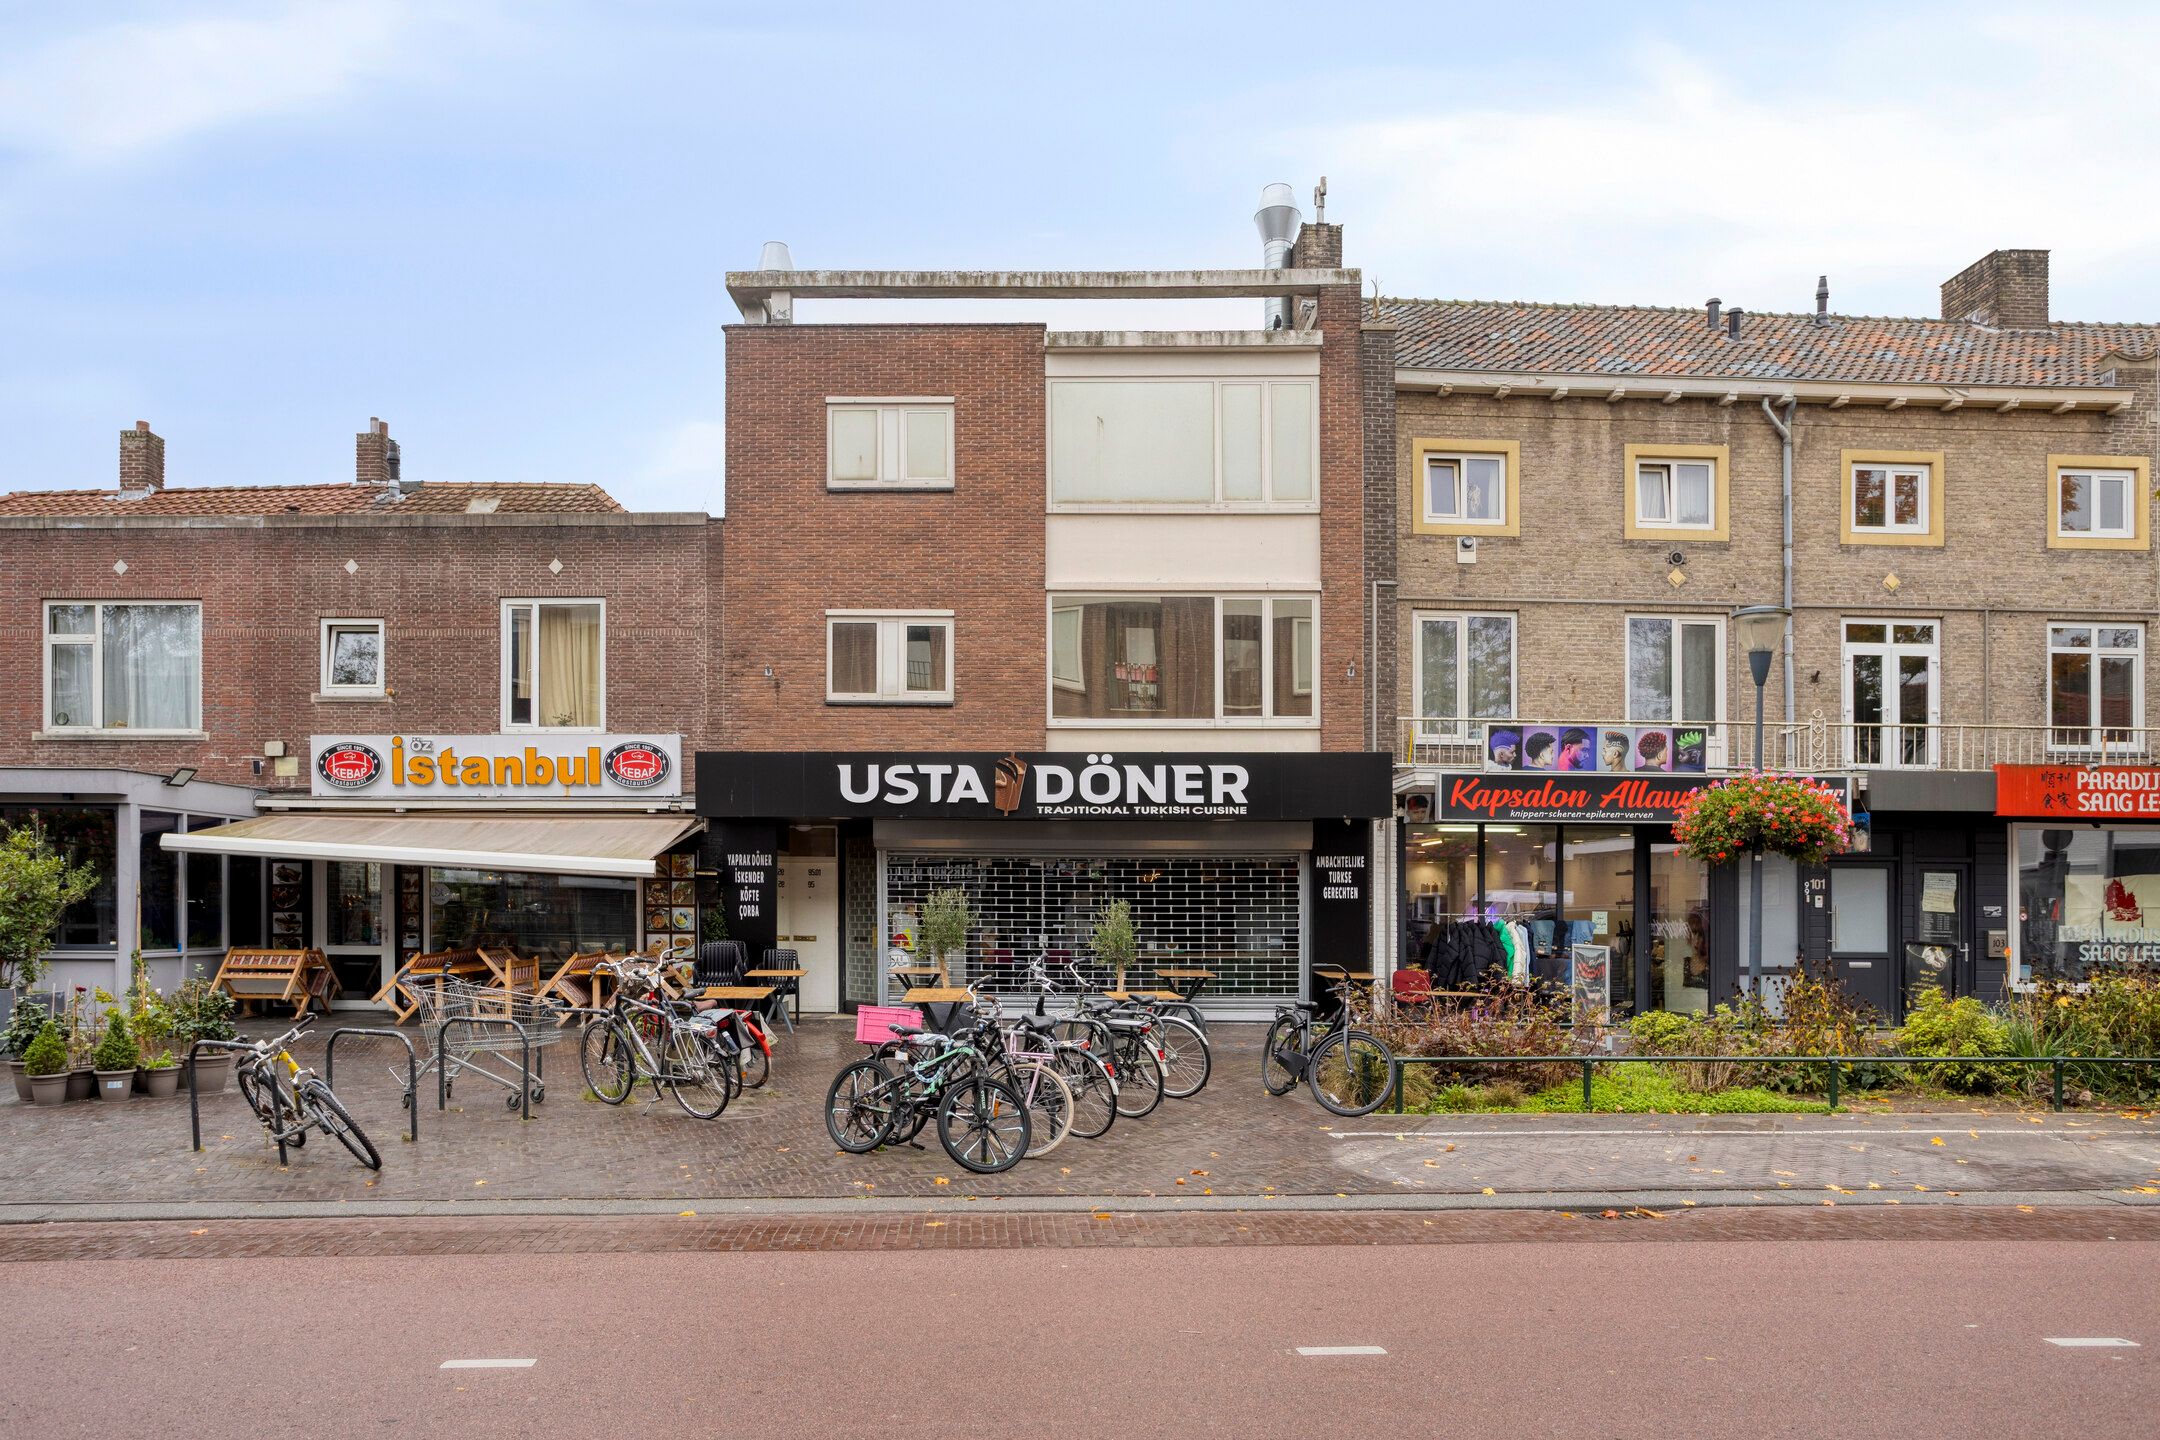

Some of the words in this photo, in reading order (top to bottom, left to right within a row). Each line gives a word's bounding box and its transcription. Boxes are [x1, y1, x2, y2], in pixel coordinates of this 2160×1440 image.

[332, 767, 367, 779] KEBAP
[620, 767, 656, 779] KEBAP
[837, 764, 989, 804] USTA
[1032, 753, 1249, 804] DÖNER
[330, 777, 367, 786] Restaurant
[617, 776, 655, 786] Restaurant
[2077, 771, 2160, 790] PARADIJ
[1450, 777, 1591, 817] Kapsalon
[2078, 792, 2133, 812] SANG
[2138, 792, 2160, 812] LE
[1037, 806, 1130, 815] TRADITIONAL
[1133, 806, 1190, 815] TURKISH
[1192, 806, 1247, 815] CUISINE
[727, 853, 751, 866] YAPRAK
[751, 850, 772, 866] DÖNER
[1316, 855, 1365, 868] AMBACHTELIJKE
[1328, 871, 1352, 883] TURKSE
[1810, 878, 1826, 890] 101
[740, 885, 760, 901] KÖFTE
[1323, 886, 1359, 899] GERECHTEN
[739, 904, 760, 920] ÇORBA
[2079, 944, 2128, 961] SANG
